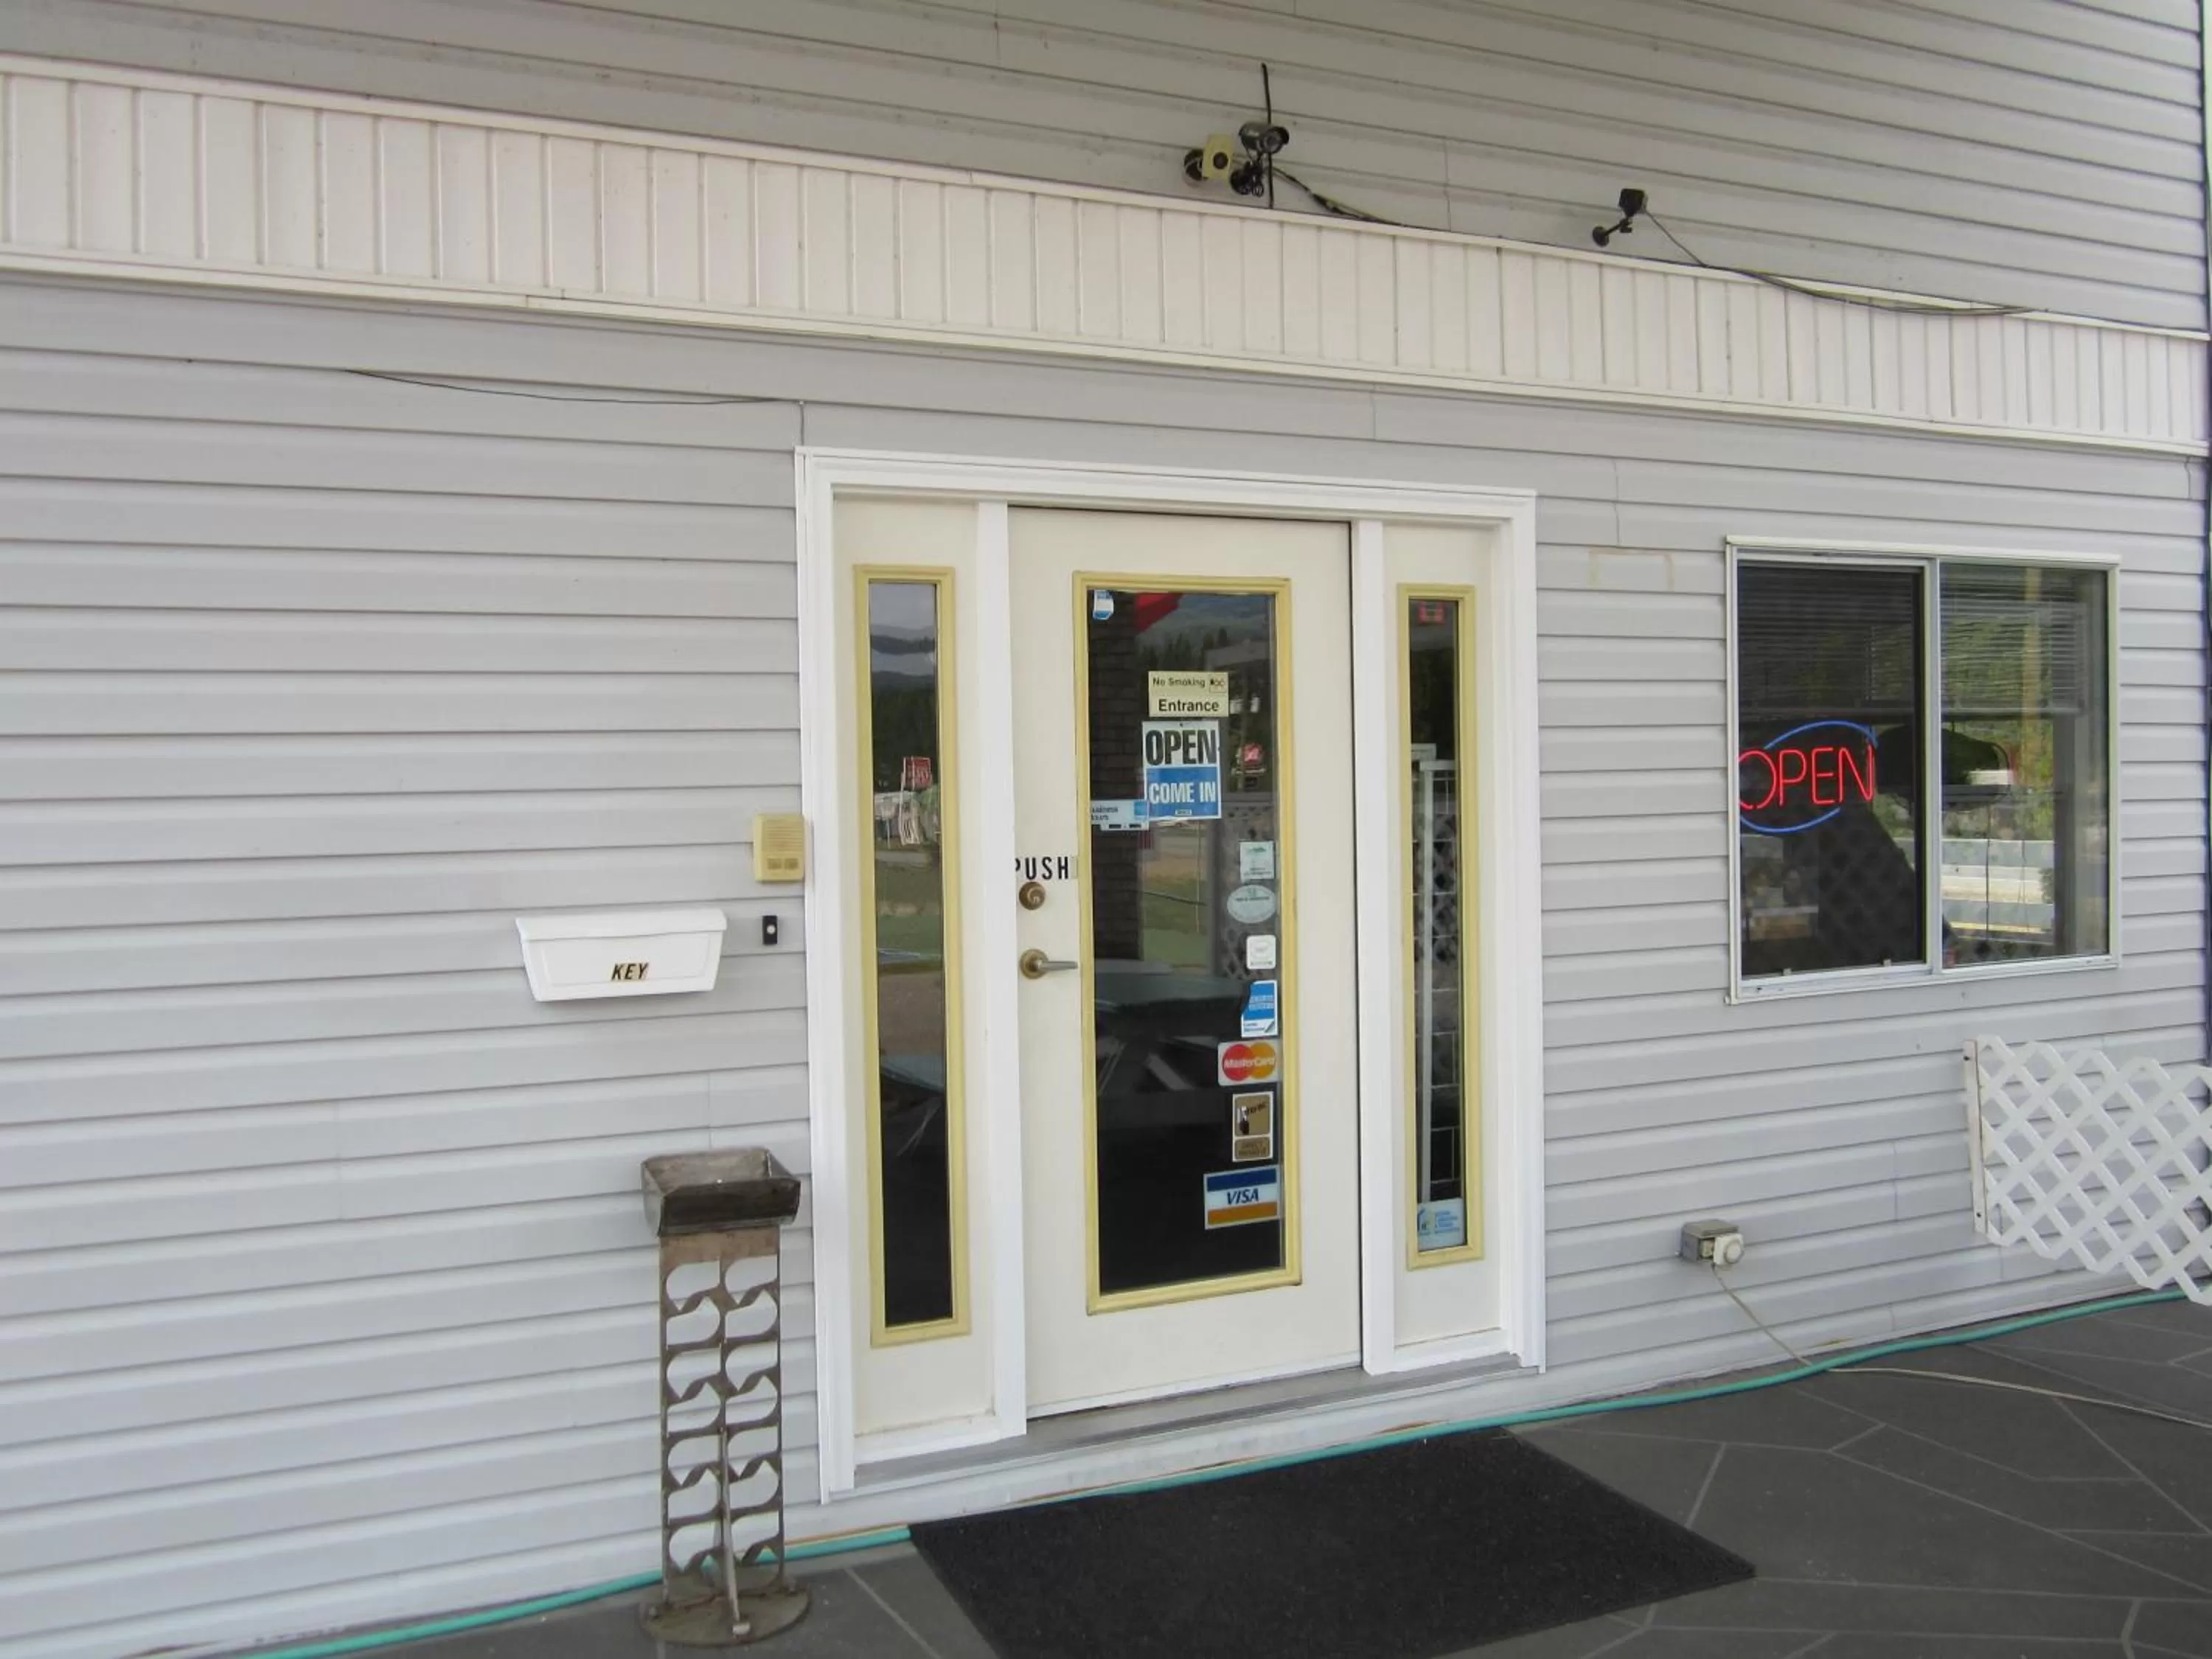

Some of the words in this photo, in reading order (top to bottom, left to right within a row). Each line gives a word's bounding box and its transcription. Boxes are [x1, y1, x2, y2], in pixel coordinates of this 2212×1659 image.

[1152, 678, 1166, 686] No
[1168, 677, 1206, 688] Smoking
[1158, 699, 1220, 712] Entrance
[1145, 729, 1217, 765] OPEN
[1738, 745, 1876, 810] OPEN
[1149, 782, 1195, 804] COME
[1199, 781, 1217, 803] IN
[611, 962, 649, 981] KEY
[1226, 1188, 1259, 1205] VISA
